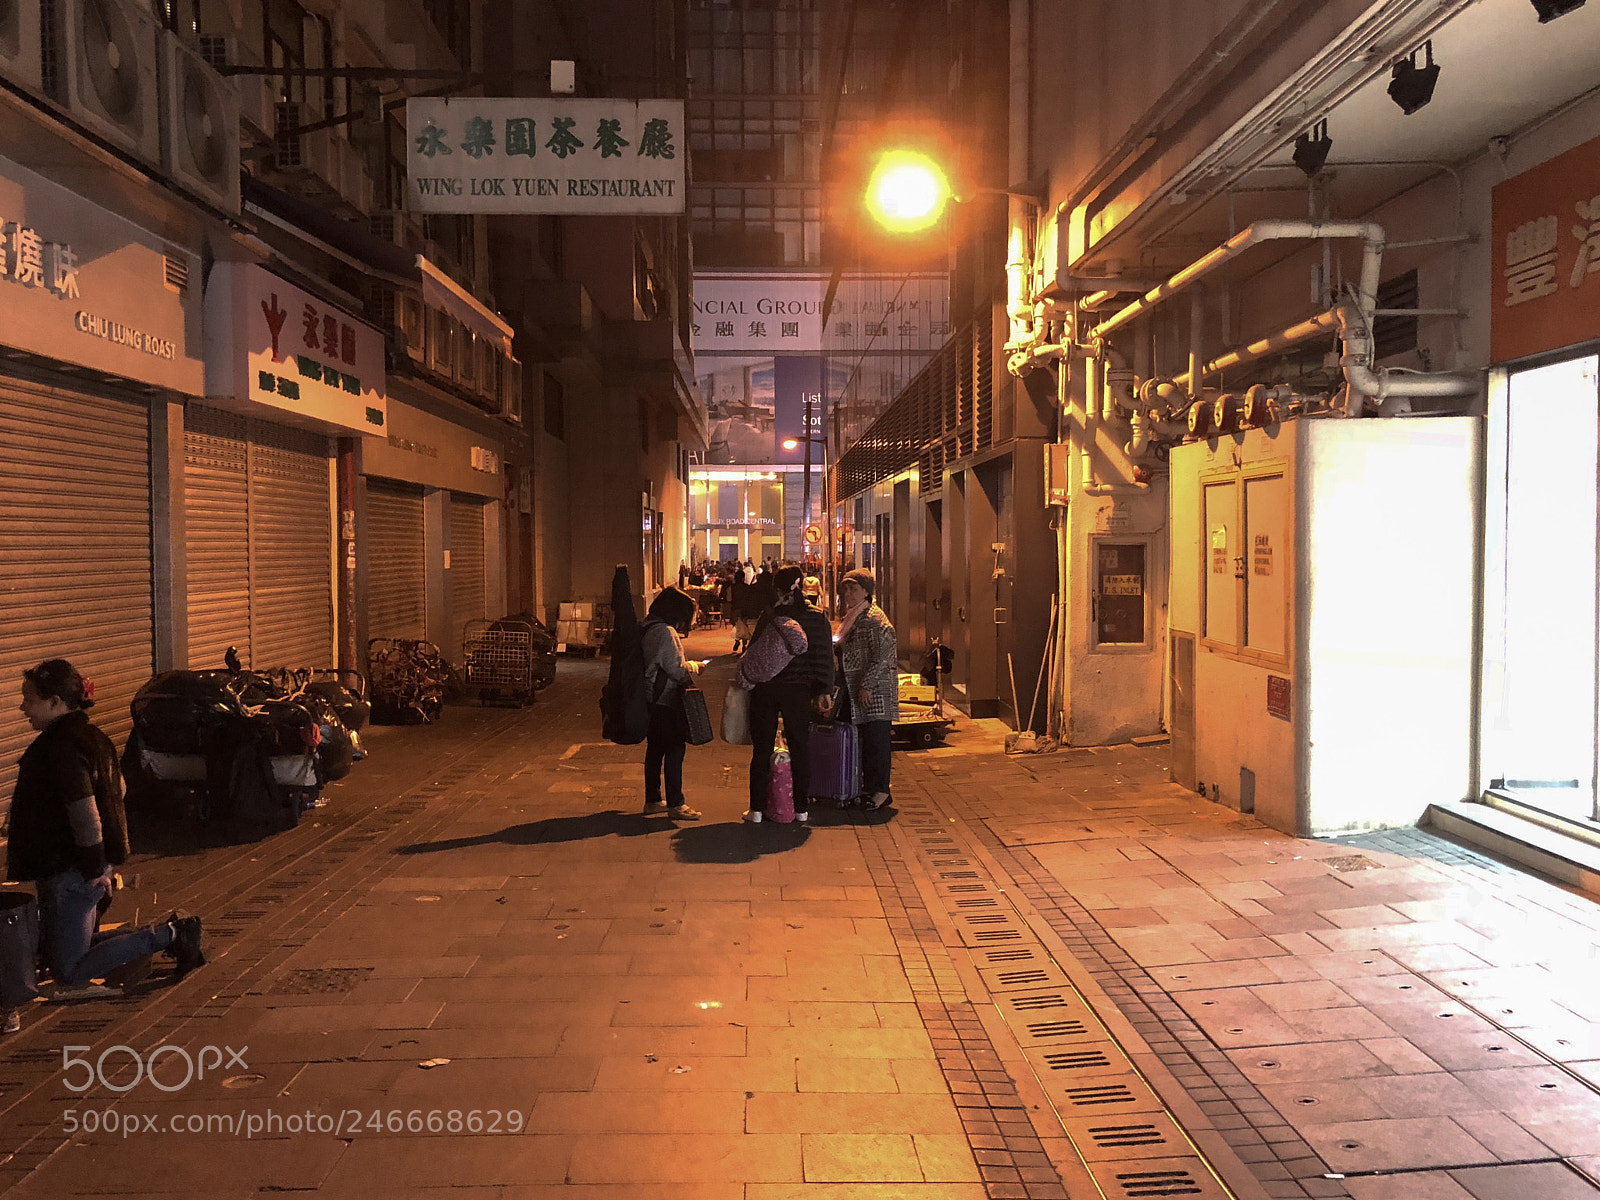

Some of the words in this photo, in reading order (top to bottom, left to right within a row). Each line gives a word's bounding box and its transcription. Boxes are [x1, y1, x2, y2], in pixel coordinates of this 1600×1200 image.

[414, 115, 677, 160] 永樂園茶餐廳
[416, 177, 463, 196] WING
[470, 177, 506, 196] LOK
[512, 177, 559, 196] YUEN
[567, 177, 676, 196] RESTAURANT
[0, 216, 81, 299] 燒味
[79, 311, 109, 338] CHIU
[112, 322, 143, 349] LUNG
[145, 334, 177, 361] ROAST
[802, 392, 821, 403] List
